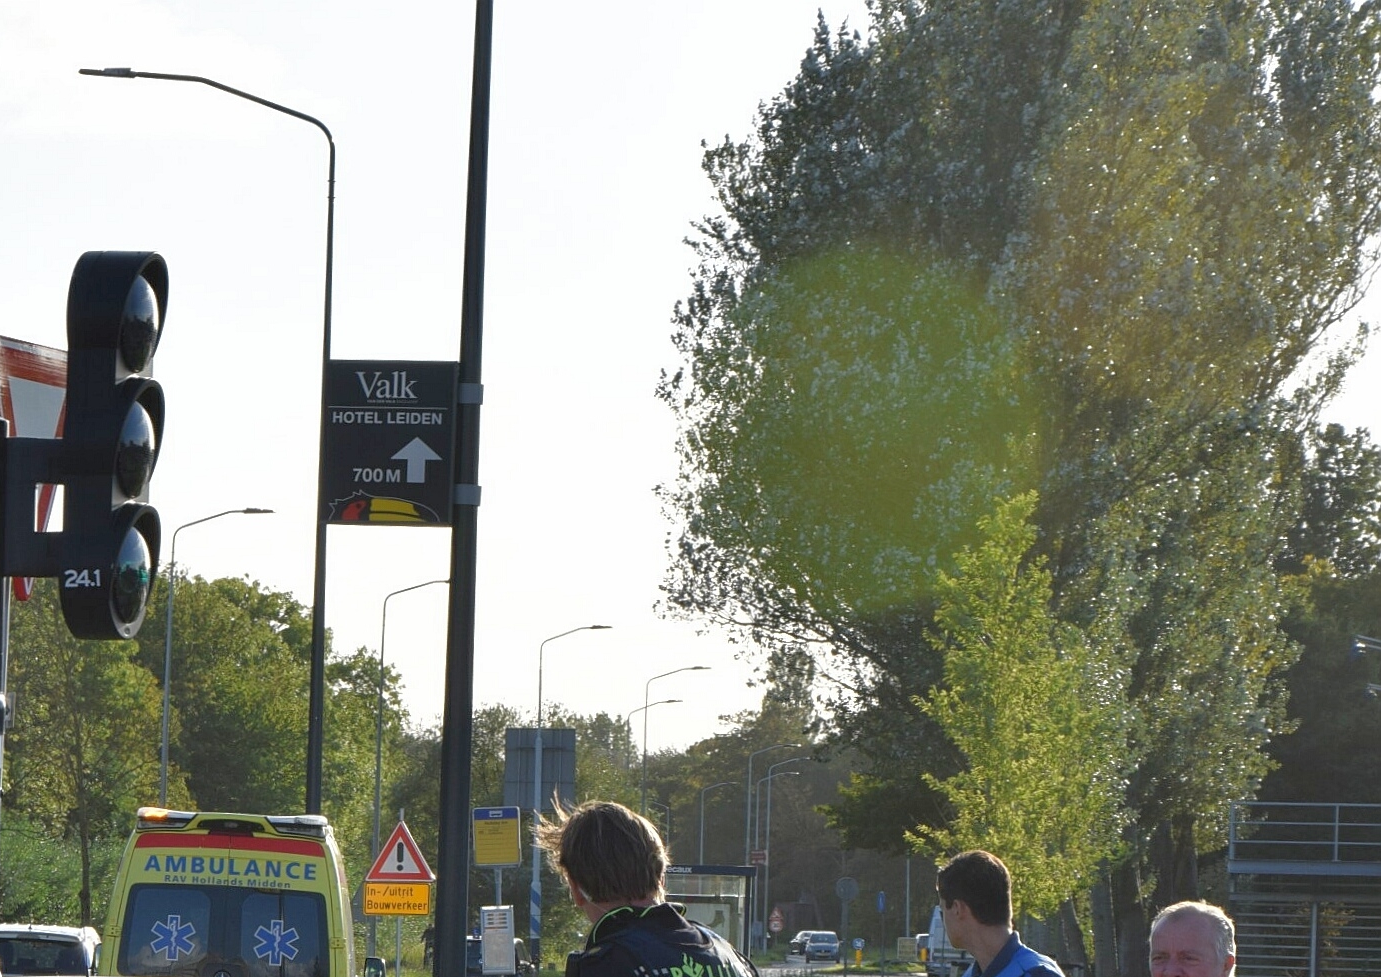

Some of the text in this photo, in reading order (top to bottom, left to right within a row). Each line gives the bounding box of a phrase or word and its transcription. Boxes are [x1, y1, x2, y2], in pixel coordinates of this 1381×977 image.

[355, 371, 419, 399] Valk
[332, 411, 443, 426] HOTEL LEIDEN
[352, 467, 401, 483] 700 M
[64, 568, 102, 588] 24.1
[144, 854, 317, 881] AMBULANCE
[164, 874, 291, 889] RAV Hollands Midden
[367, 886, 414, 897] In-/uitrit
[366, 900, 428, 911] Bouwverkeer
